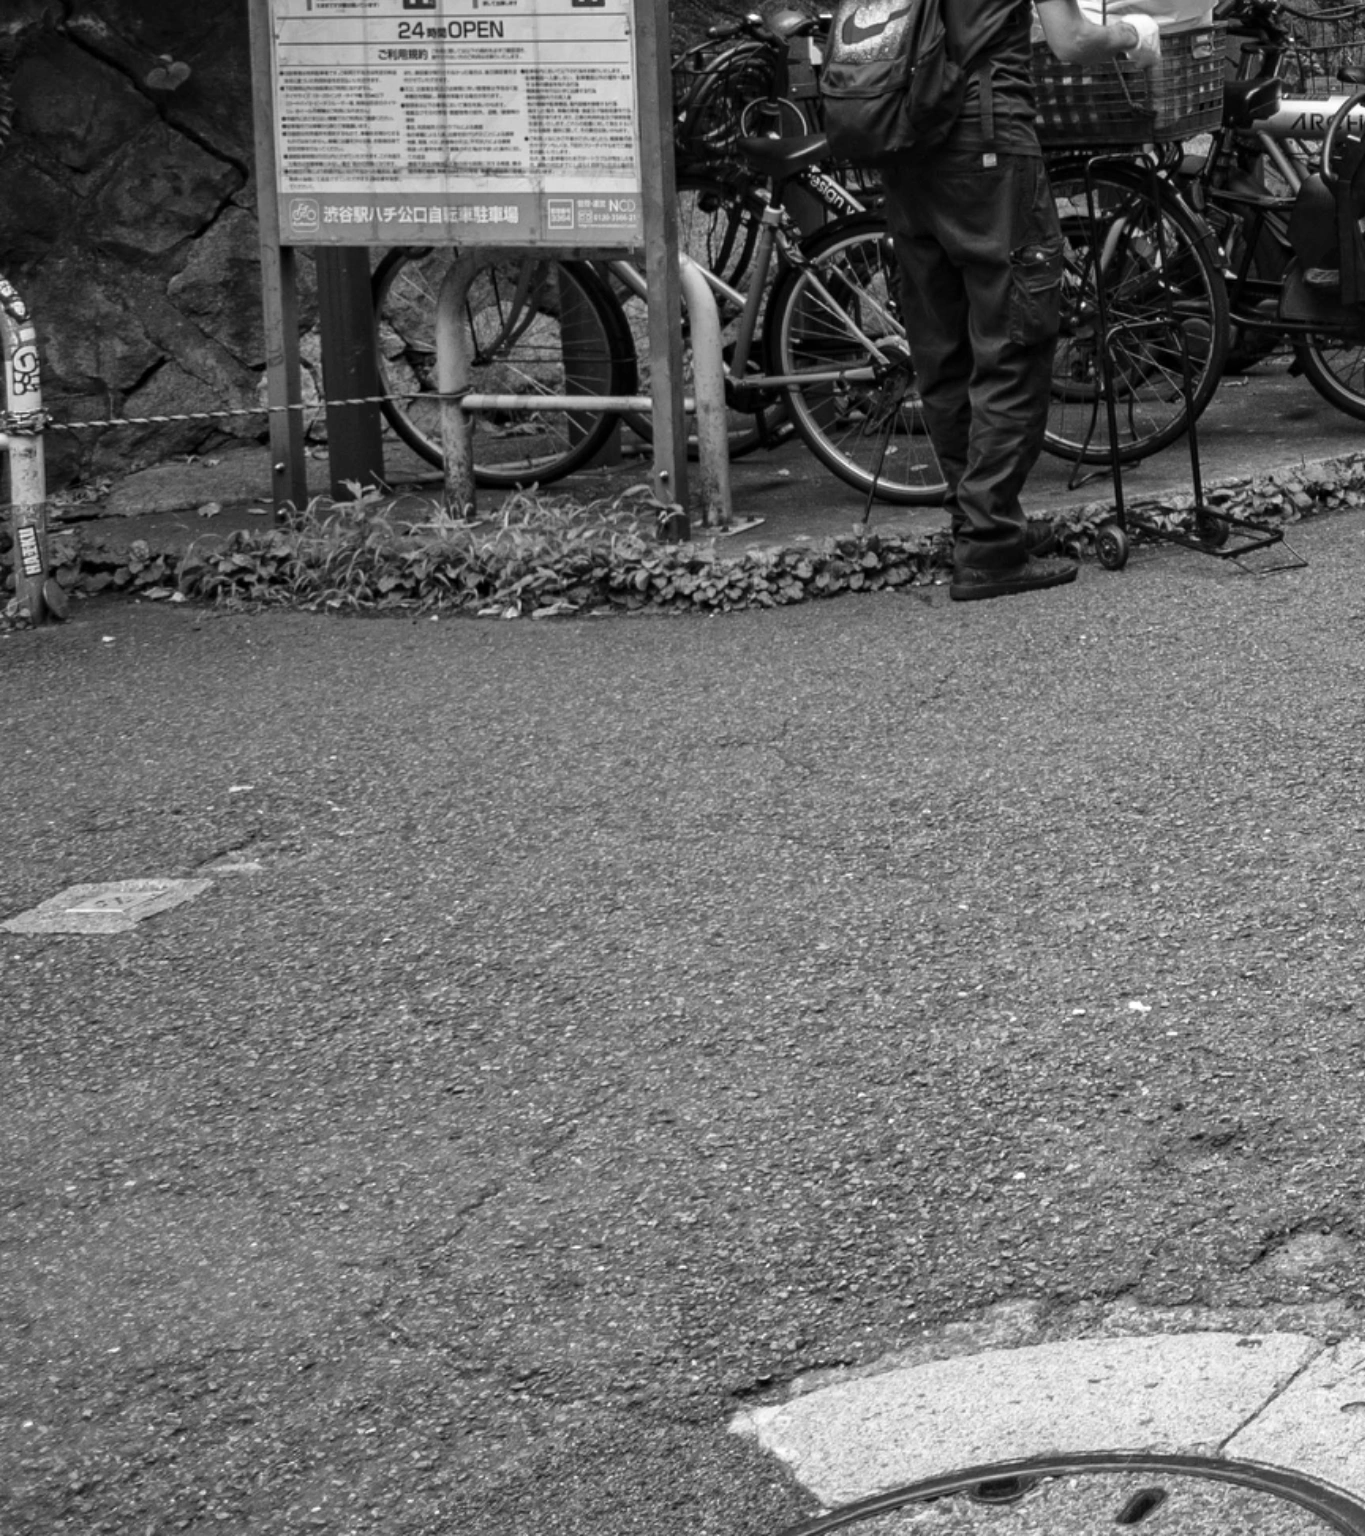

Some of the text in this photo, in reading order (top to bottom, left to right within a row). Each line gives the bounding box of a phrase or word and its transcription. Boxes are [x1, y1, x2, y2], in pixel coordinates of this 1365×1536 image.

[397, 20, 505, 41] 24時間OPEN
[322, 205, 520, 225] 渋谷駅ハチ公口自転車駐車場
